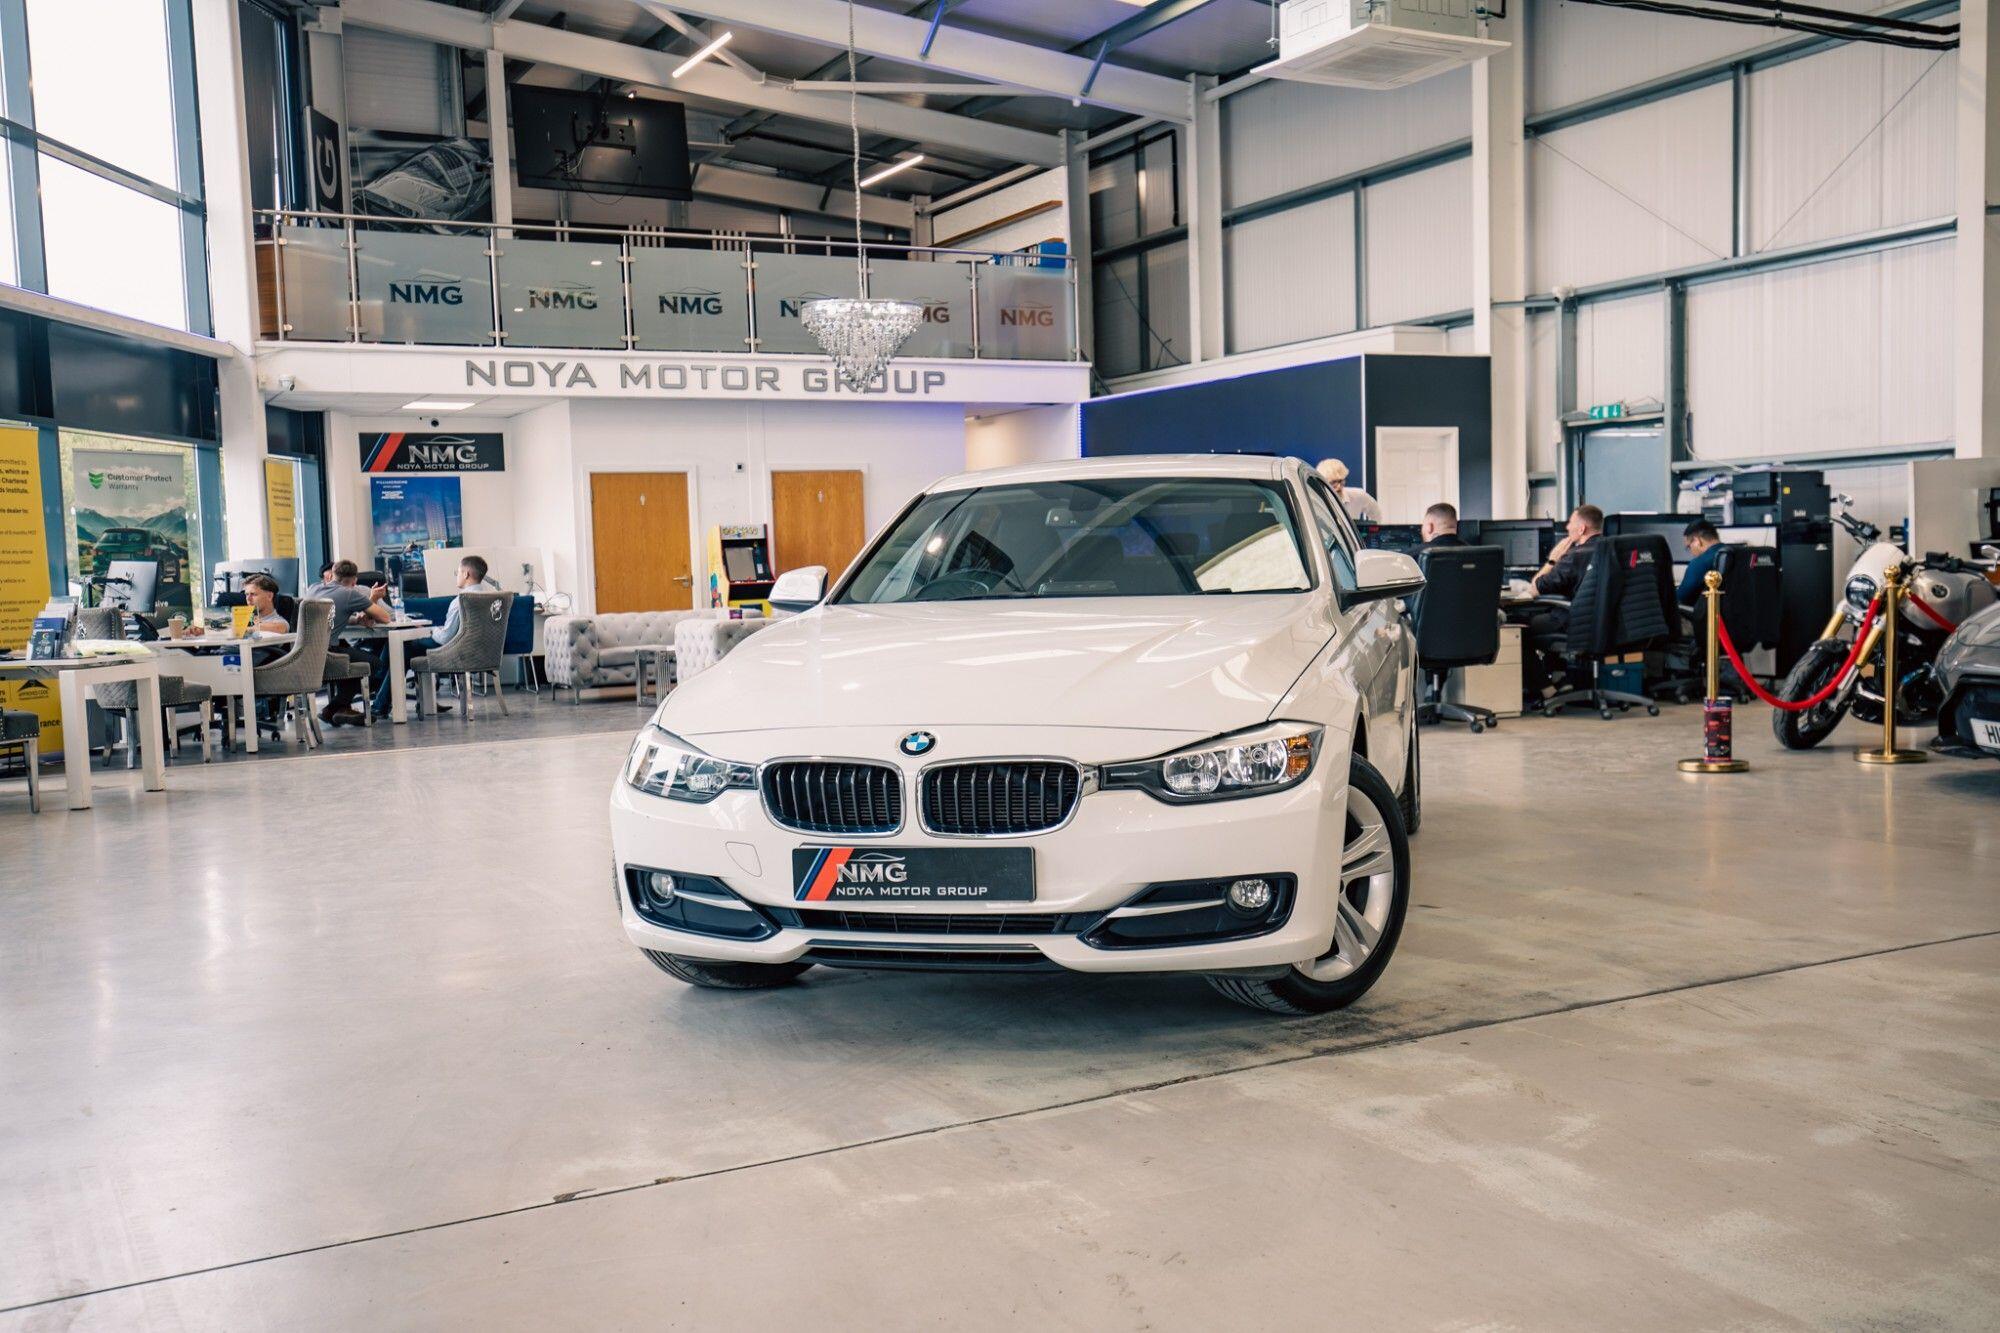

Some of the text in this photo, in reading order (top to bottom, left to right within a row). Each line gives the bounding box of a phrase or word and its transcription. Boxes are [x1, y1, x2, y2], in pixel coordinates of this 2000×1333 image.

[388, 283, 463, 305] NMG
[528, 289, 598, 310] NMG
[658, 295, 723, 315] NMG
[921, 306, 950, 323] MG
[1000, 308, 1054, 327] NMG
[465, 360, 597, 388] NOYA
[619, 363, 781, 392] MOTOR
[408, 445, 478, 463] NMG
[107, 473, 172, 482] Customer Protect
[108, 483, 140, 491] Warranty
[40, 719, 60, 728] rance
[836, 862, 908, 883] NMG
[836, 886, 988, 896] NOYA MOTOR GROUP
